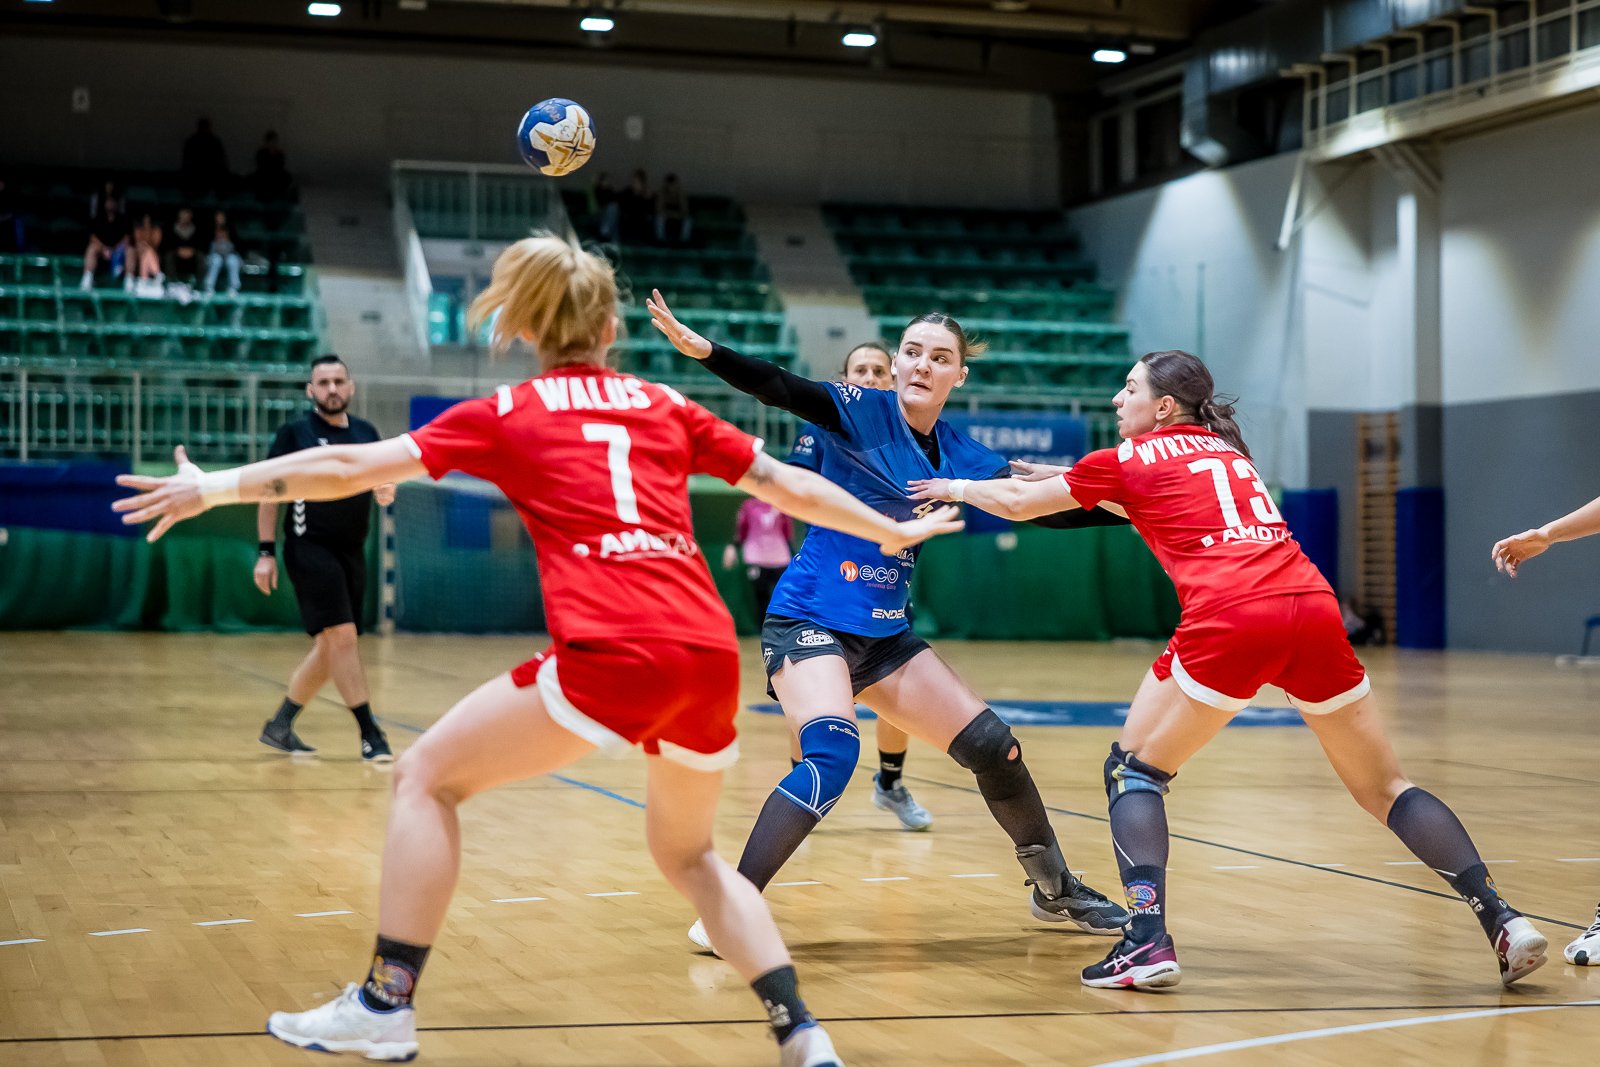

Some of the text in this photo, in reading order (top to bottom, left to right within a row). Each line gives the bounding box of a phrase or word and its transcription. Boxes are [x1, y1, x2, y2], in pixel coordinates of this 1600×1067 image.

[581, 423, 642, 524] 7
[1187, 457, 1284, 528] 73
[859, 565, 899, 584] eco
